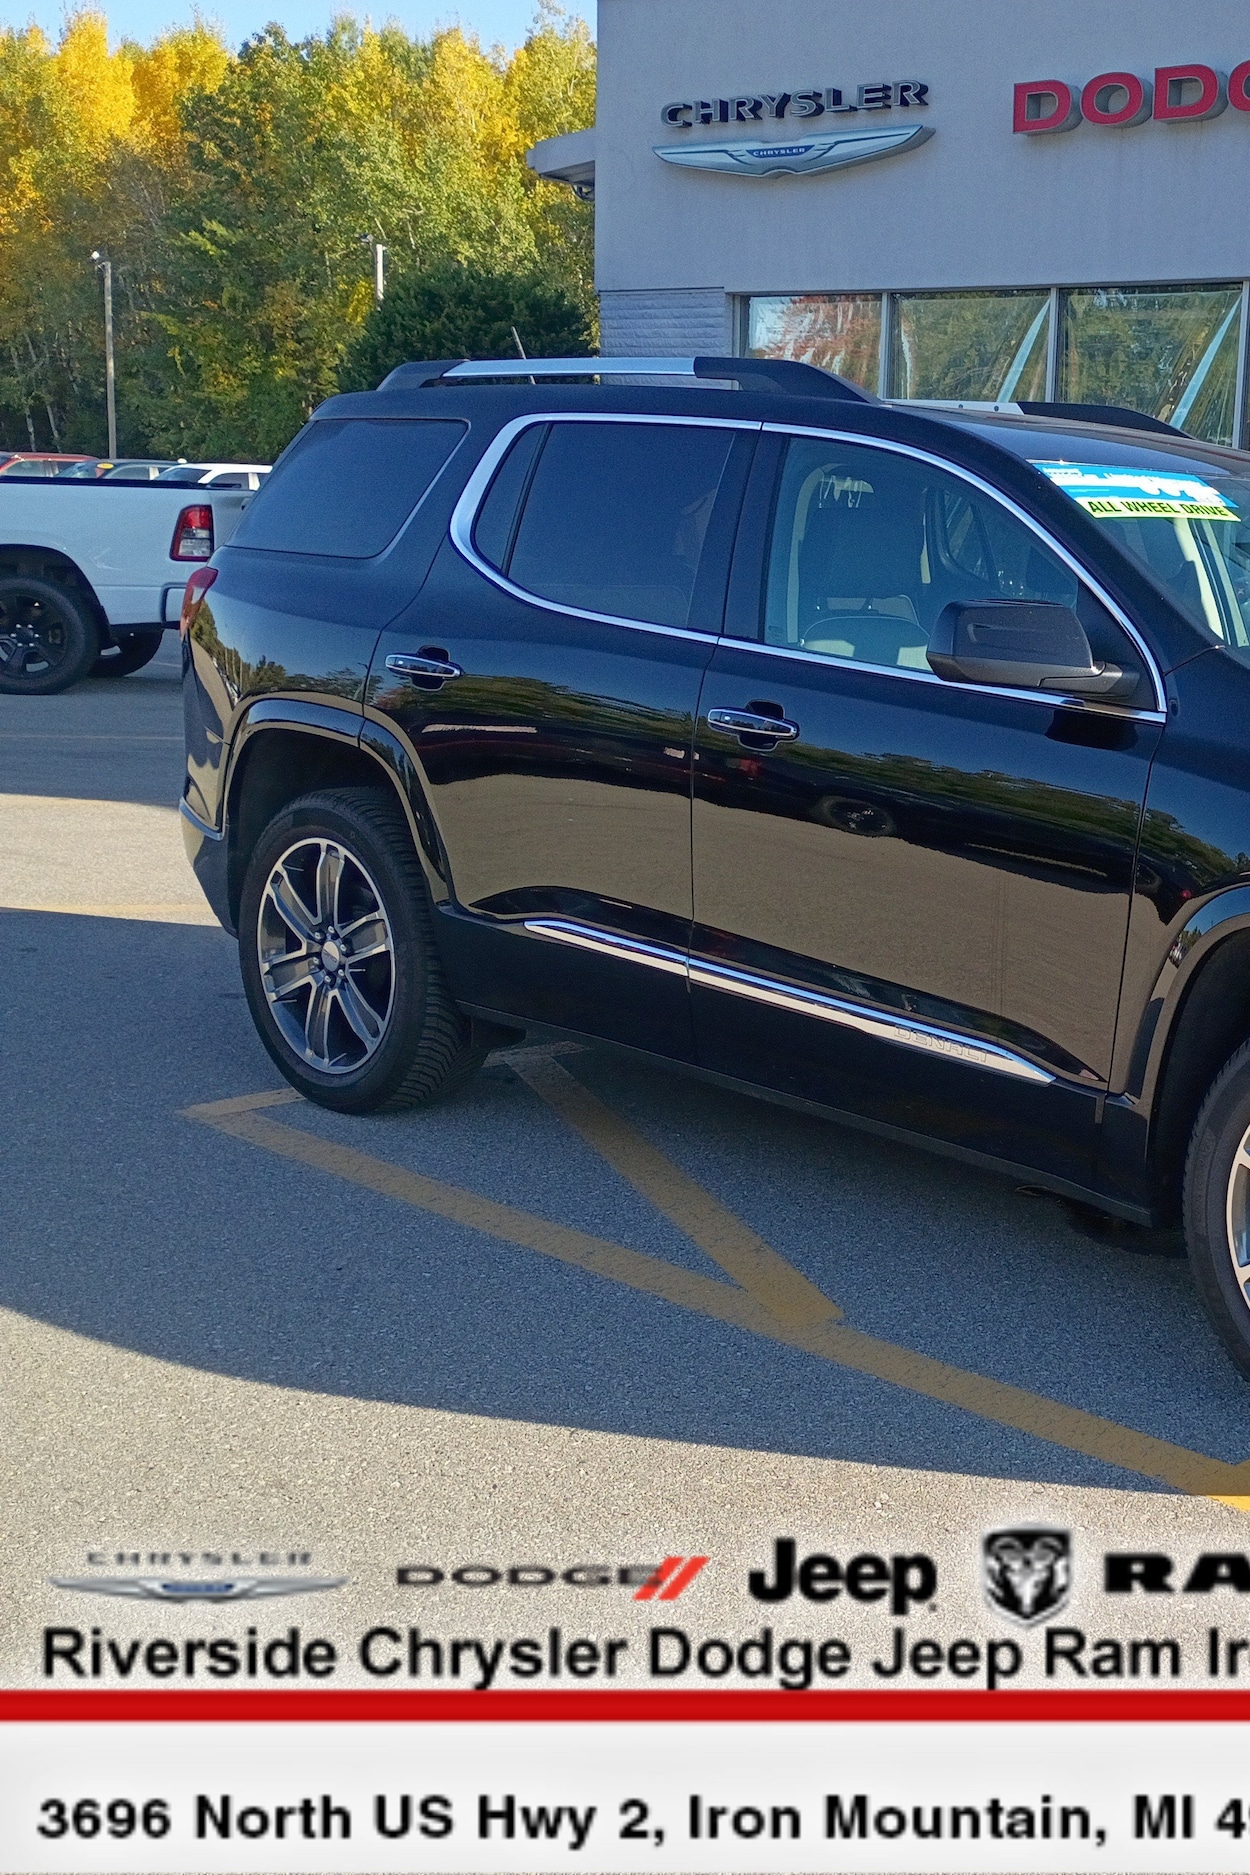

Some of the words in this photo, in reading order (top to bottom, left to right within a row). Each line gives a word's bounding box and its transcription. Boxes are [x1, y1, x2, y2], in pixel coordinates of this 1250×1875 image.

[660, 79, 929, 128] CHRYSLER
[753, 147, 805, 157] CHRYSLER
[1087, 500, 1121, 513] ALL
[1121, 501, 1180, 514] WHEEL
[1181, 503, 1228, 517] DRIVE
[893, 1025, 988, 1063] DENALI
